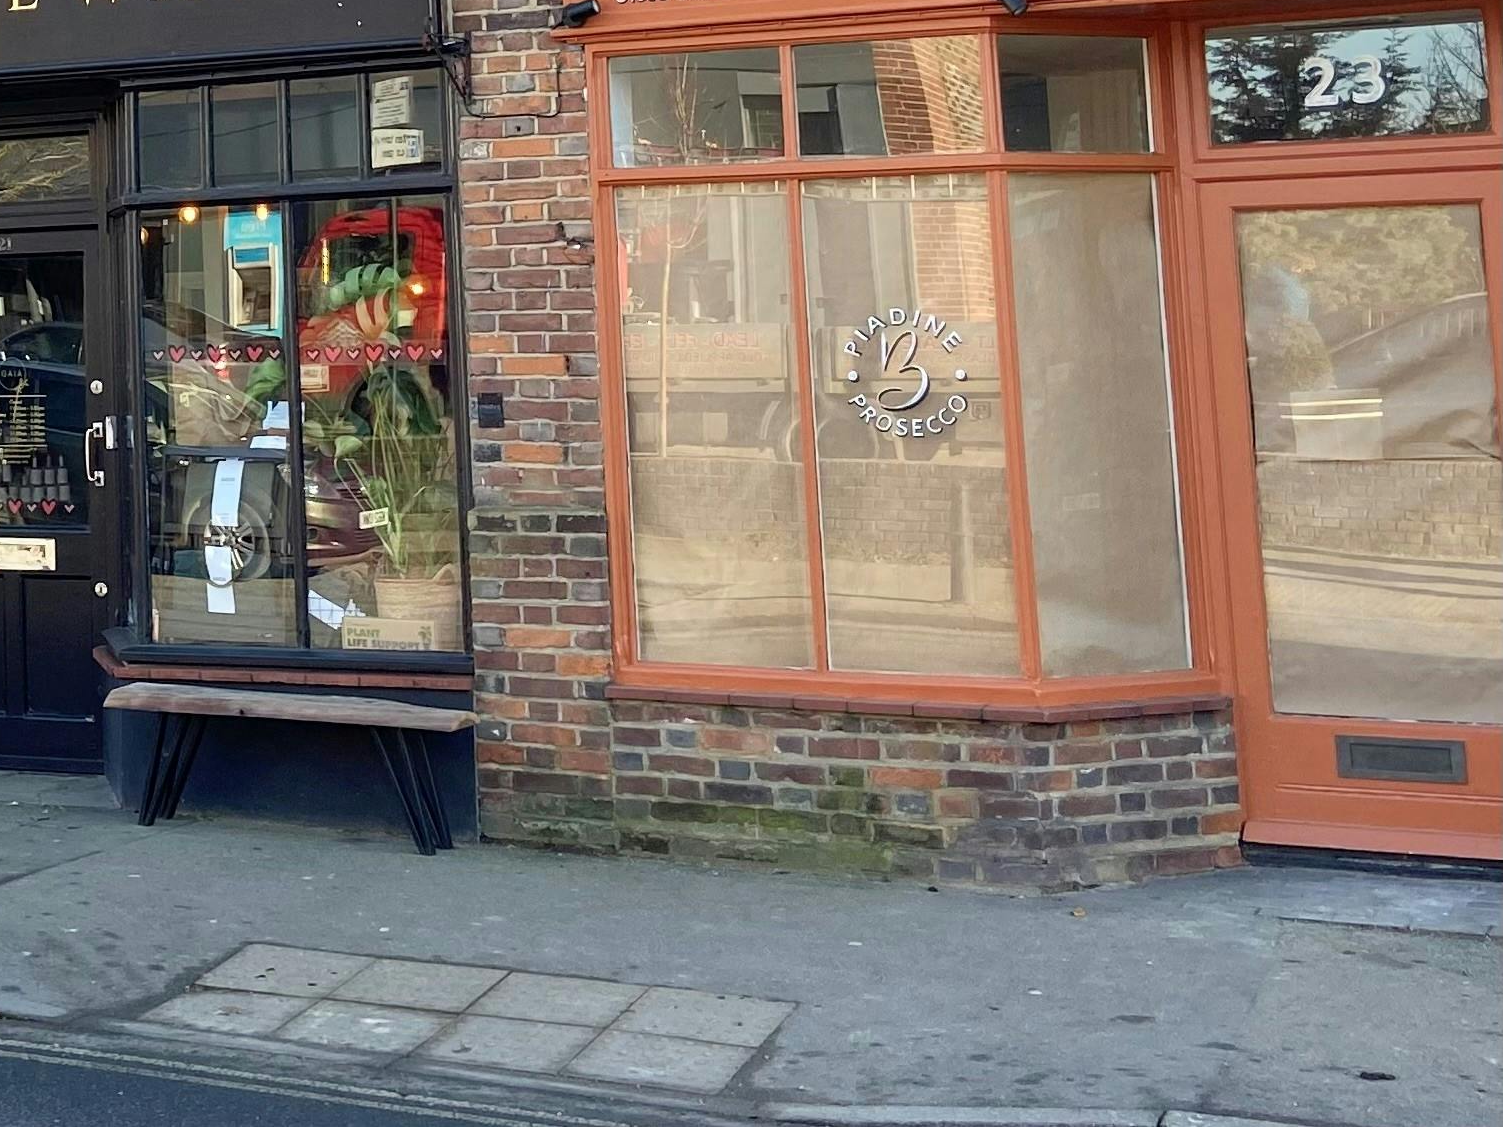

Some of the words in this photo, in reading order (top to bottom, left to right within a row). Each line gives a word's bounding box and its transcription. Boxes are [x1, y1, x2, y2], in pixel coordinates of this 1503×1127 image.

[1303, 55, 1387, 108] 23
[843, 307, 963, 358] PIADINE
[847, 394, 968, 438] PROSECCO
